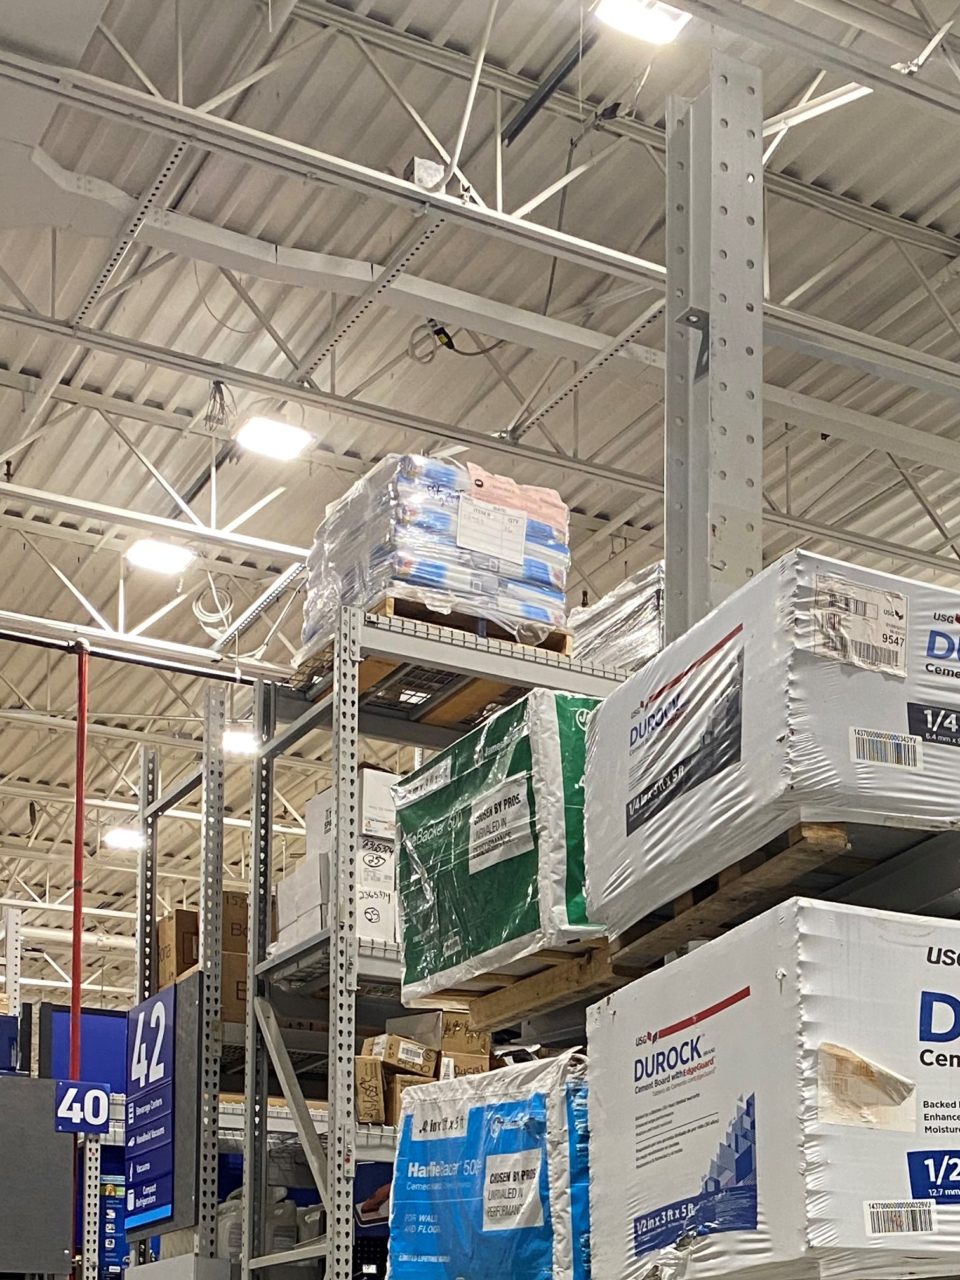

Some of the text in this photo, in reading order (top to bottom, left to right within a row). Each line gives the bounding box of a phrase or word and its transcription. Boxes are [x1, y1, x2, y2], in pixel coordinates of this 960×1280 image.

[933, 612, 954, 624] USG
[882, 633, 905, 648] 9547
[923, 709, 958, 732] 1/4
[131, 1001, 165, 1088] 42
[635, 1036, 647, 1047] USG
[634, 1034, 702, 1082] DUROCK
[634, 1081, 653, 1095] Cement
[654, 1075, 671, 1088] Board
[57, 1088, 109, 1126] 40
[923, 1100, 957, 1110] Backed
[928, 1188, 944, 1197] 12.7
[636, 1219, 648, 1234] 1/2
[661, 1211, 667, 1223] 3
[681, 1204, 687, 1216] 5
